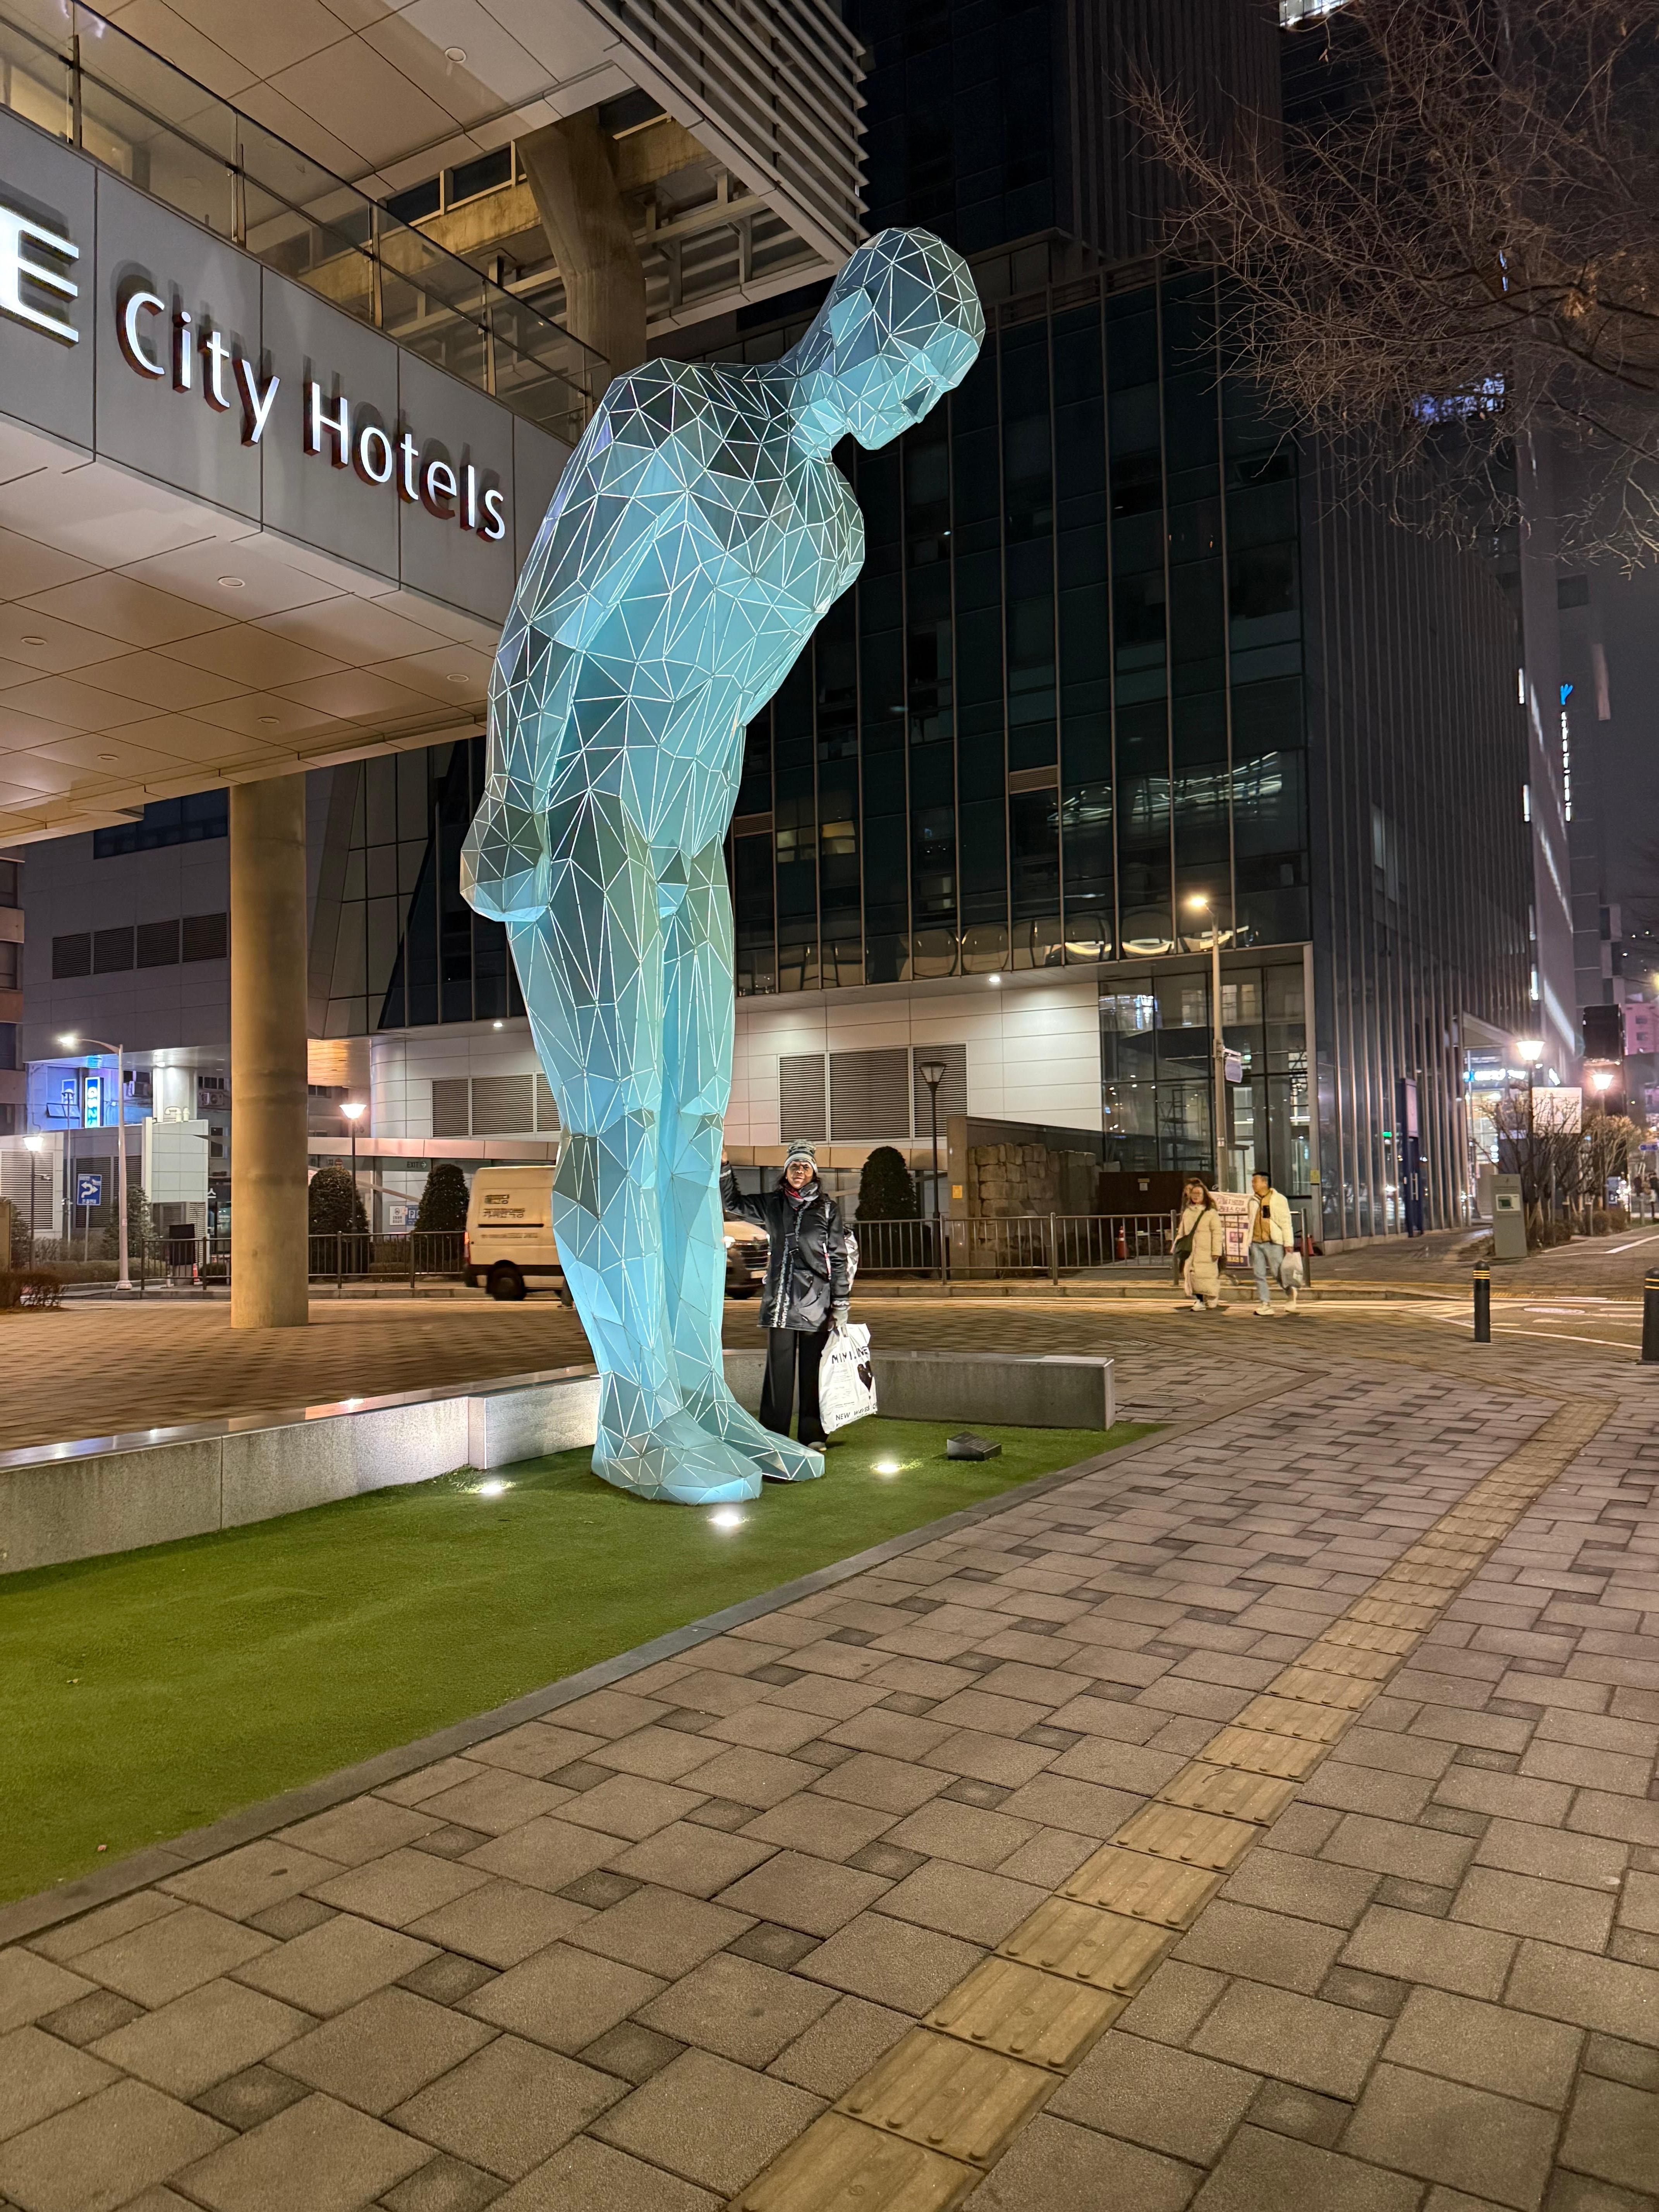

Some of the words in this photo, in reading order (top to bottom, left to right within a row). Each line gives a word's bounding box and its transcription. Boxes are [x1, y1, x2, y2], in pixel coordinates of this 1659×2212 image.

[125, 292, 280, 443] City
[311, 381, 505, 540] Hotels
[836, 1412, 850, 1421] NEW
